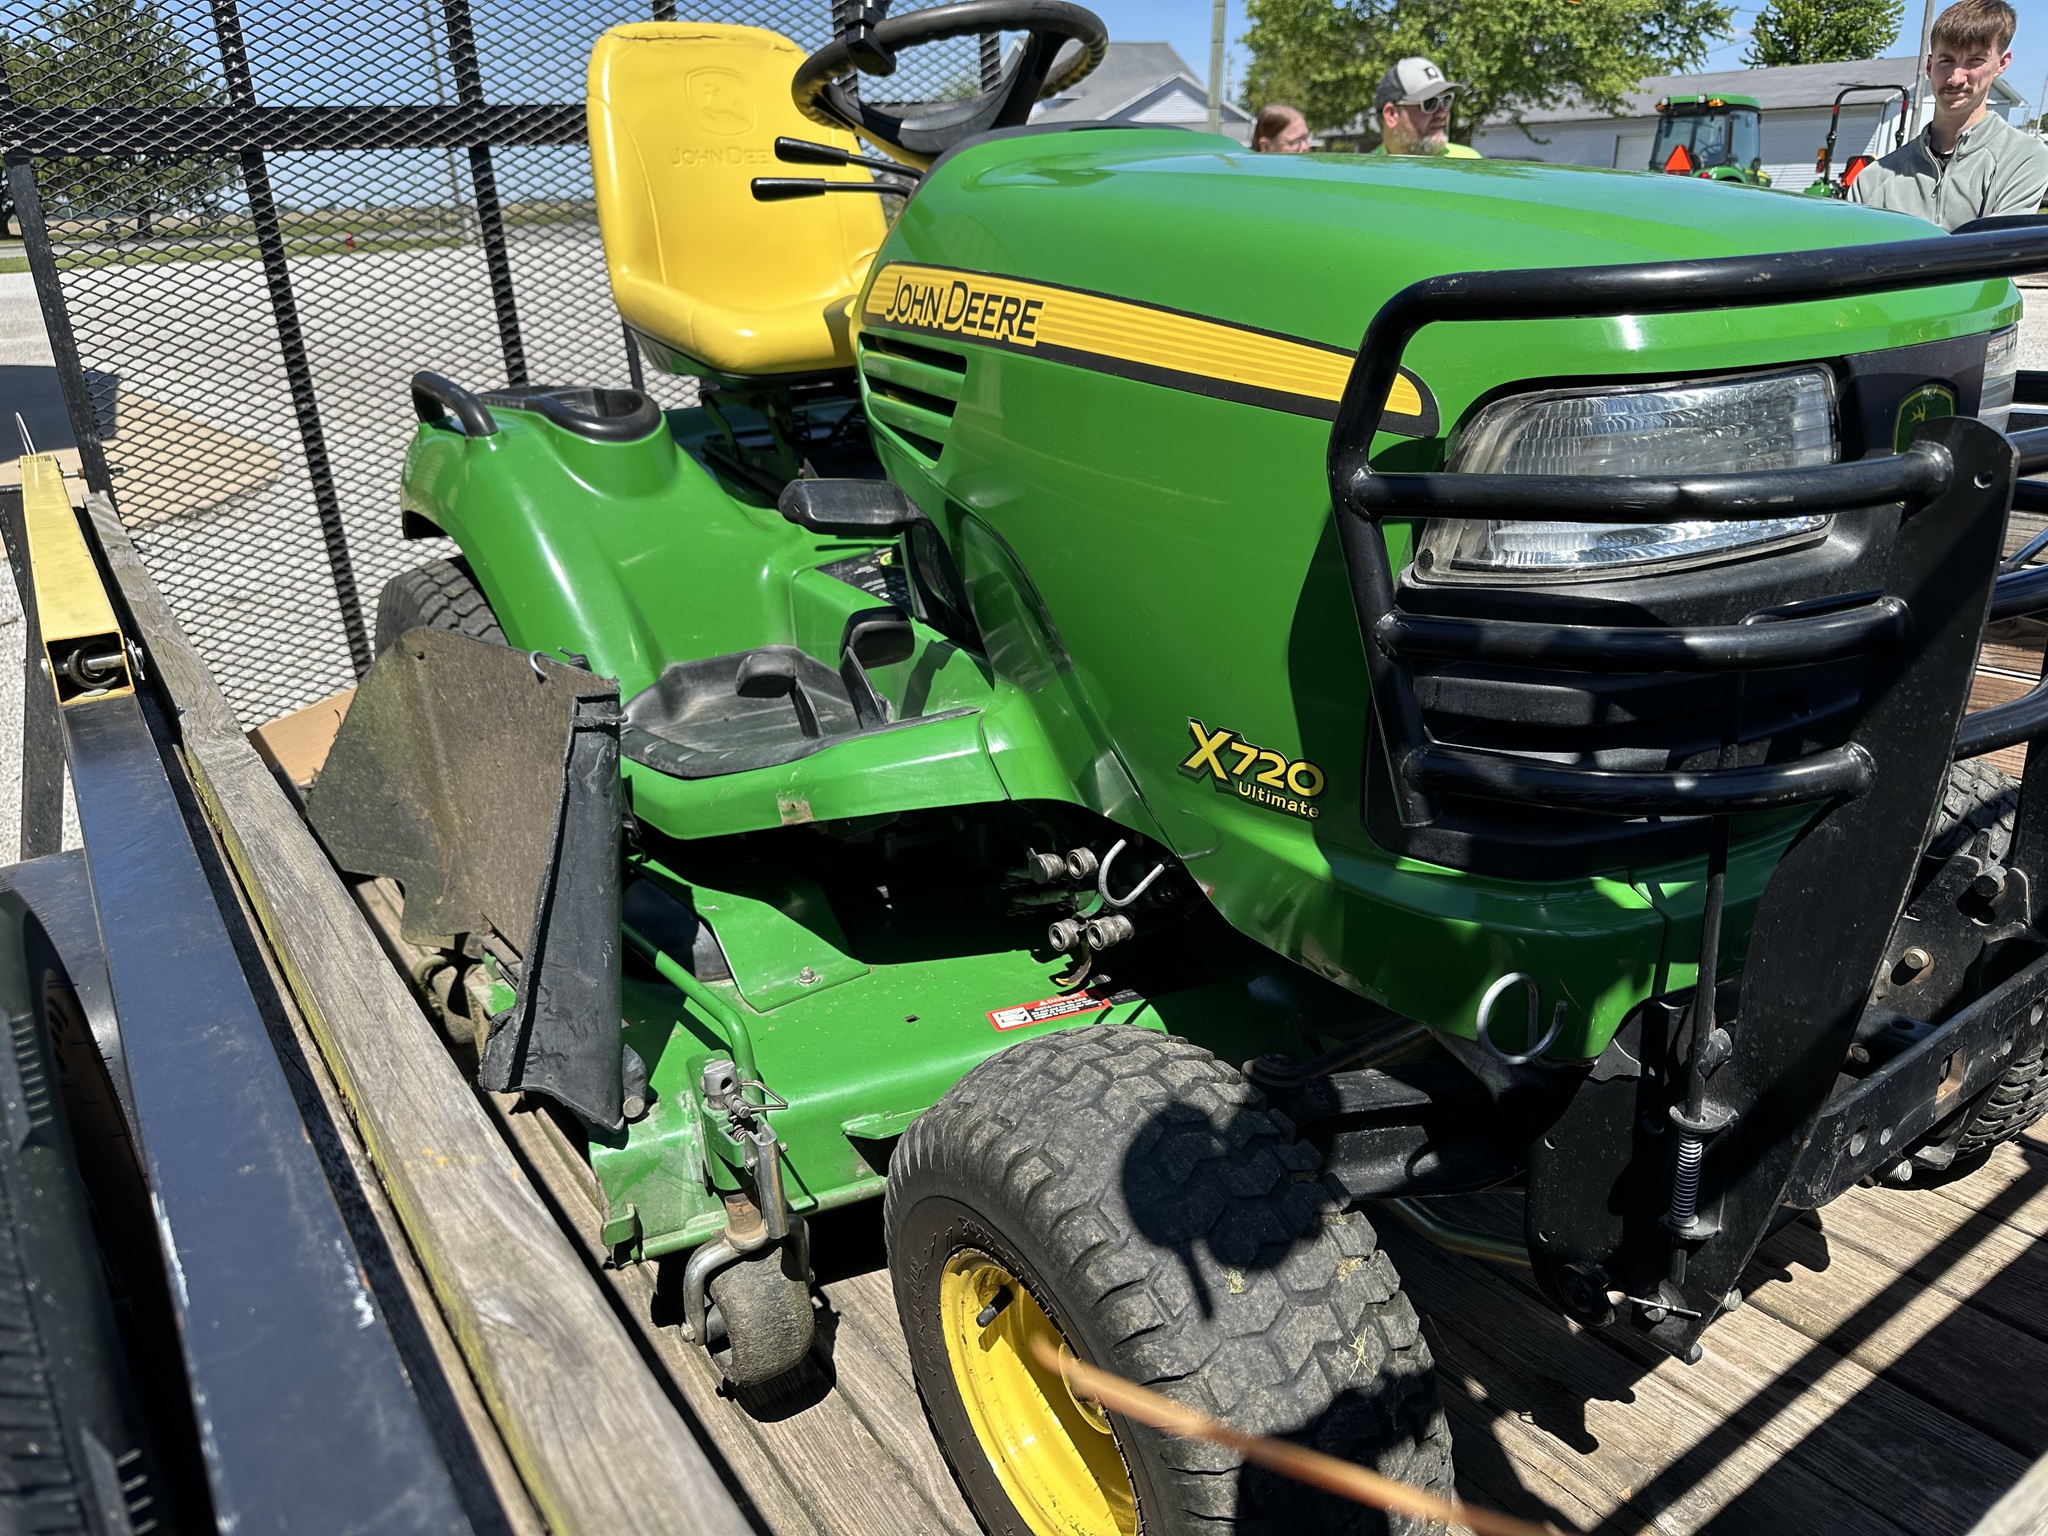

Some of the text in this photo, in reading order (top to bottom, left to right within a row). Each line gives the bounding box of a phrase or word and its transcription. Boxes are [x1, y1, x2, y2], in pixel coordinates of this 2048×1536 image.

[672, 146, 775, 168] JOHN DEE
[885, 275, 1045, 341] JOHN DEERE
[1182, 720, 1326, 798] X720
[1237, 780, 1320, 819] Ultimate
